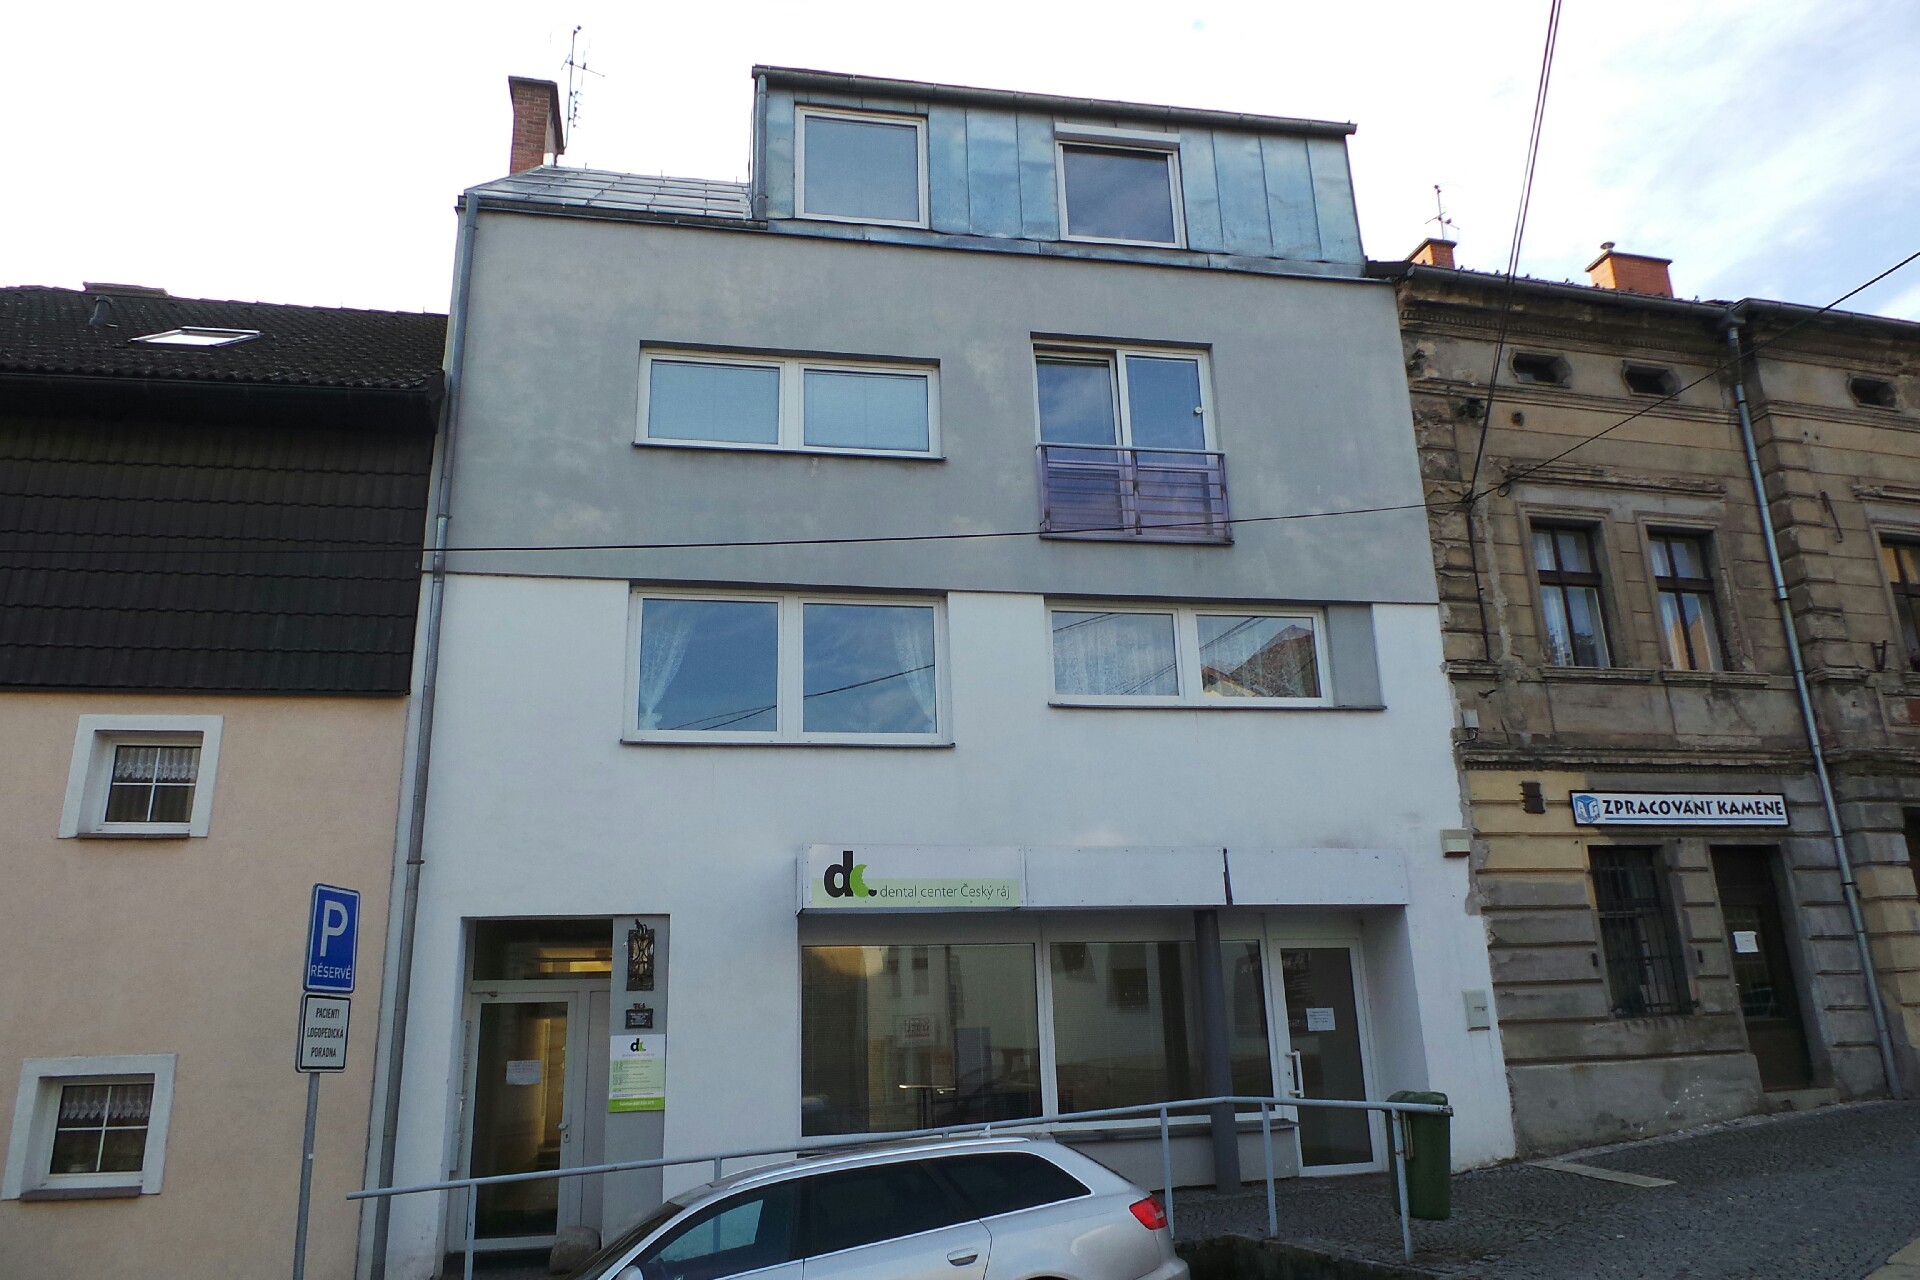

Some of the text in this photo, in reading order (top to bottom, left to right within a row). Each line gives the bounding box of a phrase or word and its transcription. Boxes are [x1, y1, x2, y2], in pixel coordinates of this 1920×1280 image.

[1602, 799, 1784, 816] ZPRACOVÁNÍ KAMENE
[880, 883, 1010, 900] dental center Český ráj
[319, 899, 349, 957] P
[310, 962, 352, 980] RÉSERVÉ
[315, 1007, 340, 1019] PACIENTI
[306, 1026, 344, 1039] LOGOPEDICKÁ
[310, 1046, 337, 1058] PORADNA
